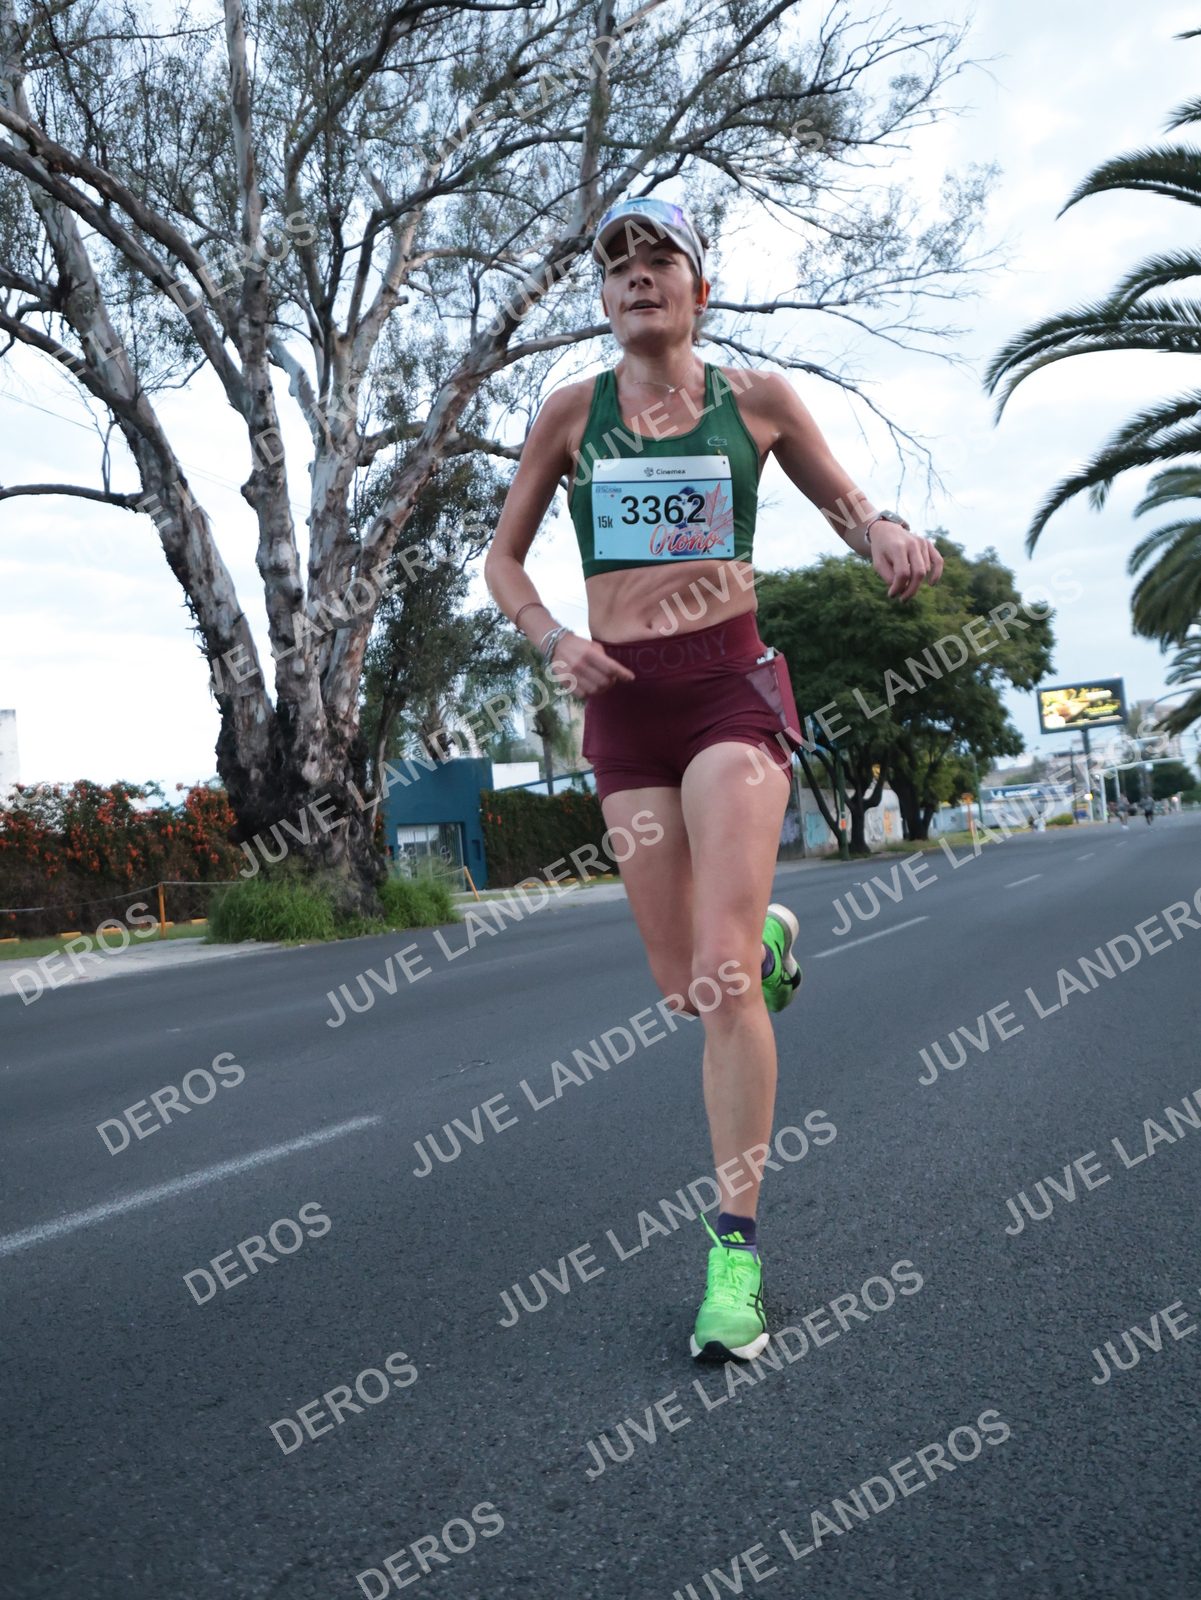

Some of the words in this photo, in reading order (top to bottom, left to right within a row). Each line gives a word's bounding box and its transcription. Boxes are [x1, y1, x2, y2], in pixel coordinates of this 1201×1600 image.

[656, 468, 686, 476] Cinemex
[620, 494, 706, 525] 3362
[597, 515, 613, 529] 15k
